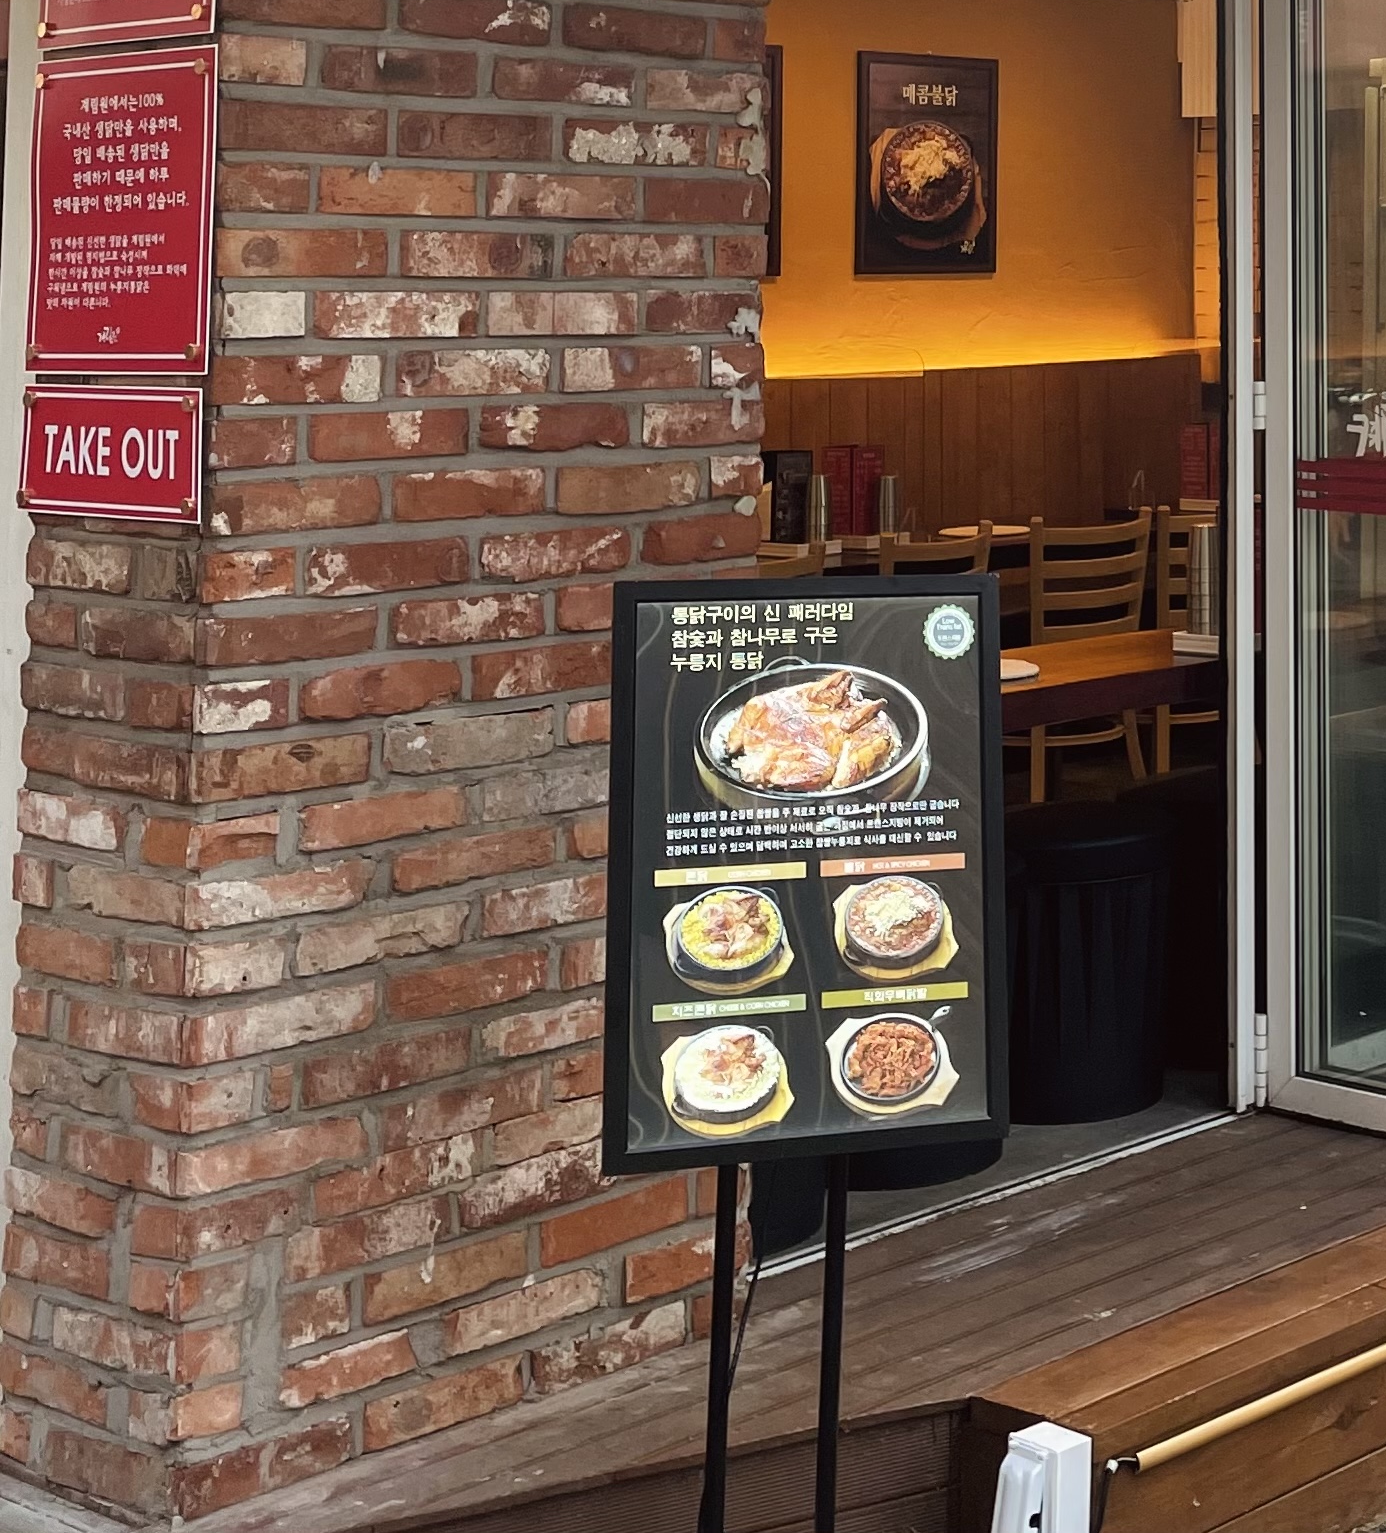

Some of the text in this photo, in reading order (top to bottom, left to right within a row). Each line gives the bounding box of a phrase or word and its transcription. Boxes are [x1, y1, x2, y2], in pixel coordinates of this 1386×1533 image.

[902, 83, 959, 107] 매콤불닭
[62, 122, 91, 140] 국내산
[73, 146, 92, 165] 당일
[103, 192, 142, 213] 한정되어
[44, 424, 180, 481] TAKE OUT
[671, 602, 854, 626] 통닭구이의 신 패러다임
[671, 629, 723, 649] 참숯과
[730, 627, 798, 647] 참나무로
[729, 651, 764, 671] 통닭
